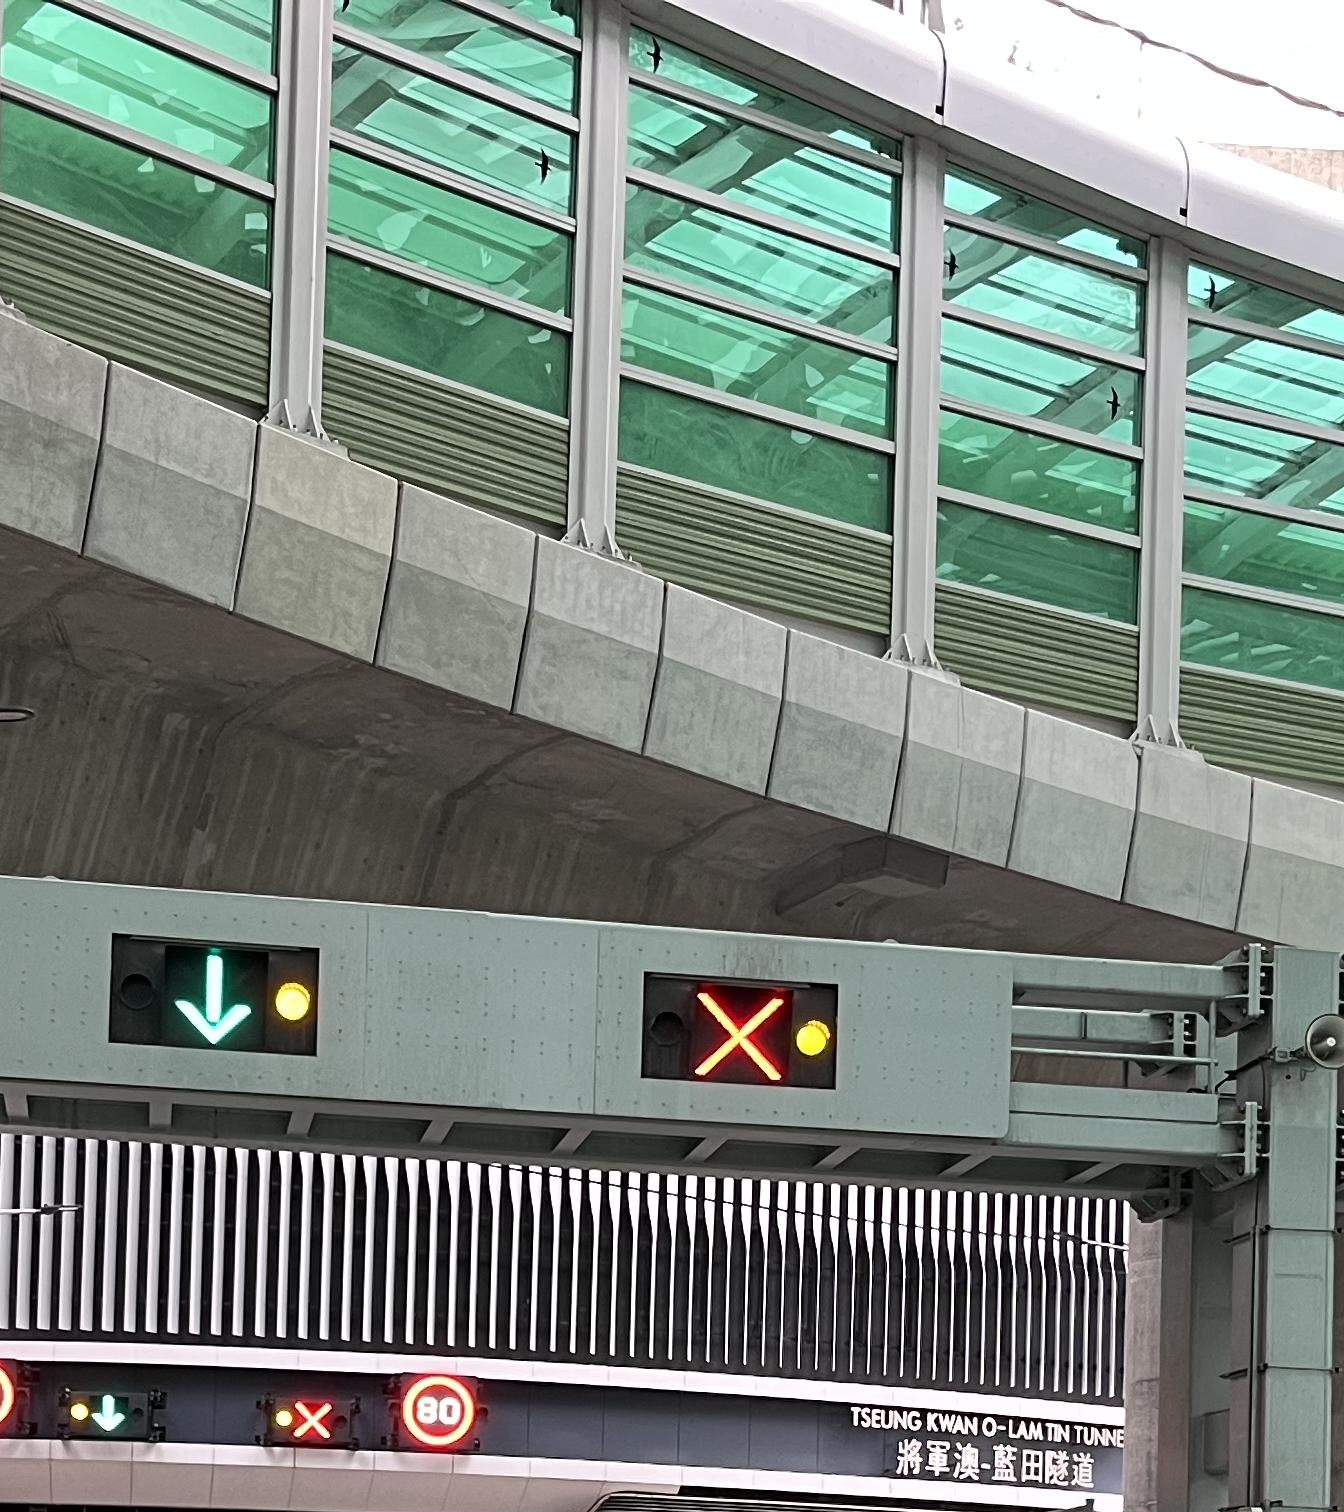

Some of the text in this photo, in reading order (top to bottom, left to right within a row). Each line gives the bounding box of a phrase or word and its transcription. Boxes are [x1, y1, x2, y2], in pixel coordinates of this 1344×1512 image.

[416, 1397, 461, 1424] 80
[850, 1406, 922, 1432] TSEUNG
[927, 1412, 978, 1436] KWAN
[1046, 1422, 1070, 1443] TIN
[1074, 1425, 1124, 1448] TUNNE
[895, 1438, 1095, 1488] 將軍澳-藍田隧道
